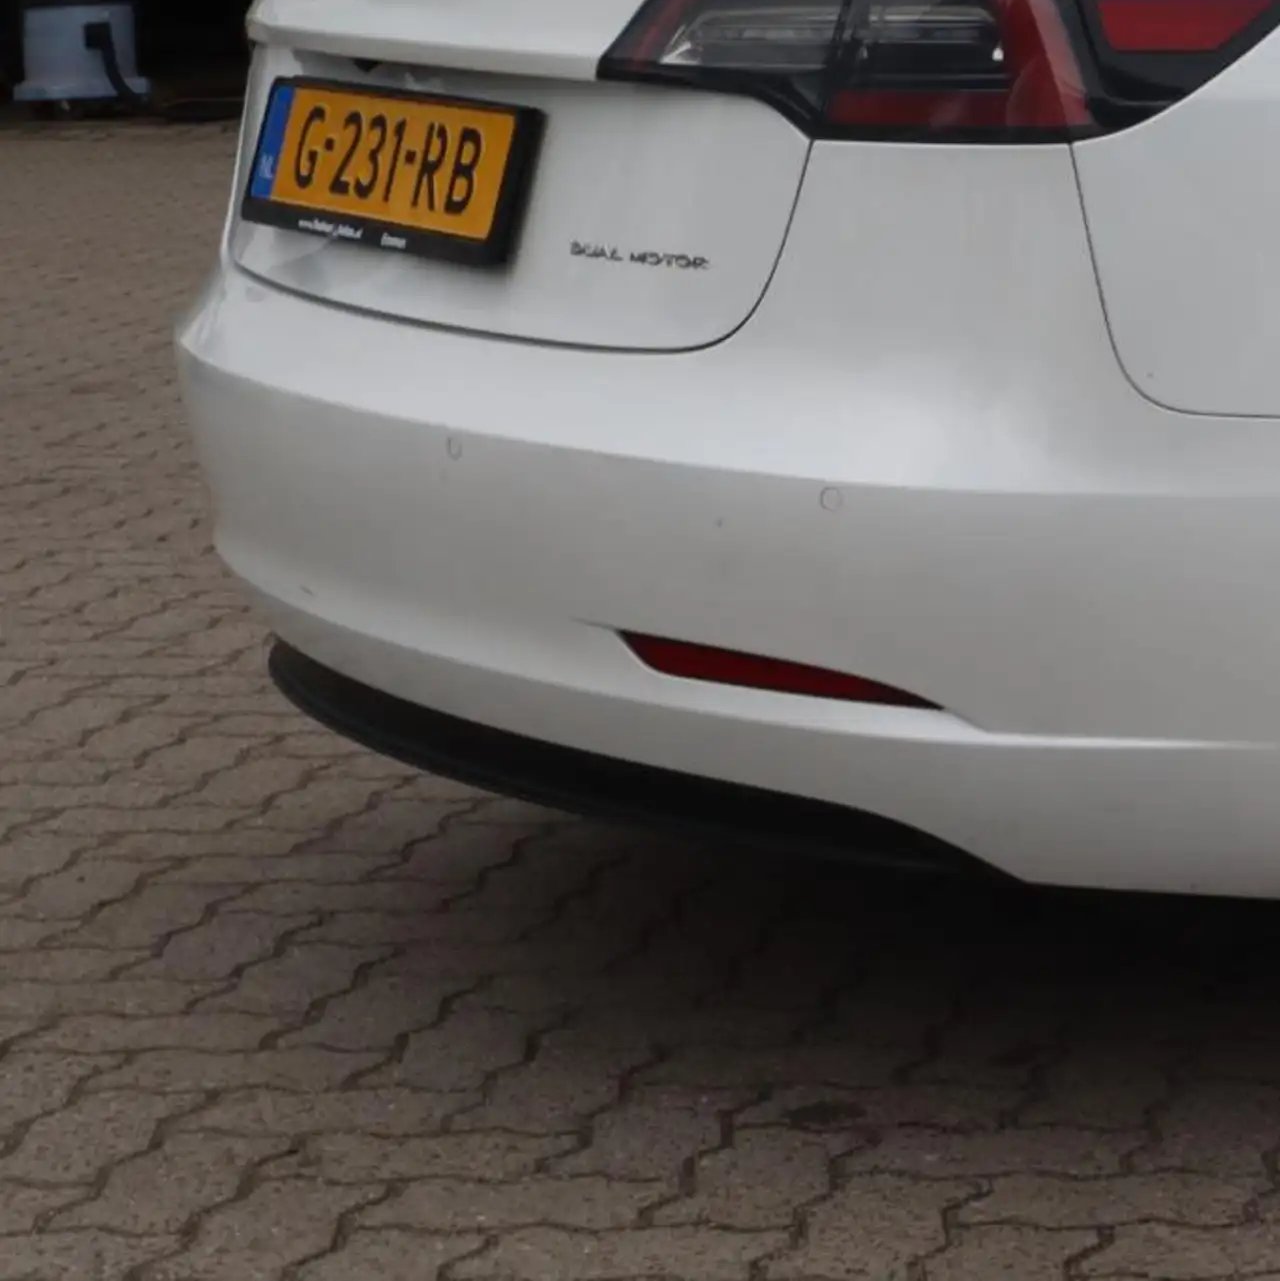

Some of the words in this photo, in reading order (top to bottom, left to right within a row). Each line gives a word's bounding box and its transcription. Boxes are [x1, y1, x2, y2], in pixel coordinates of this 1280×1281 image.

[294, 105, 483, 215] G-231-RB
[570, 240, 623, 262] DUAL
[629, 251, 710, 269] MOTOR
